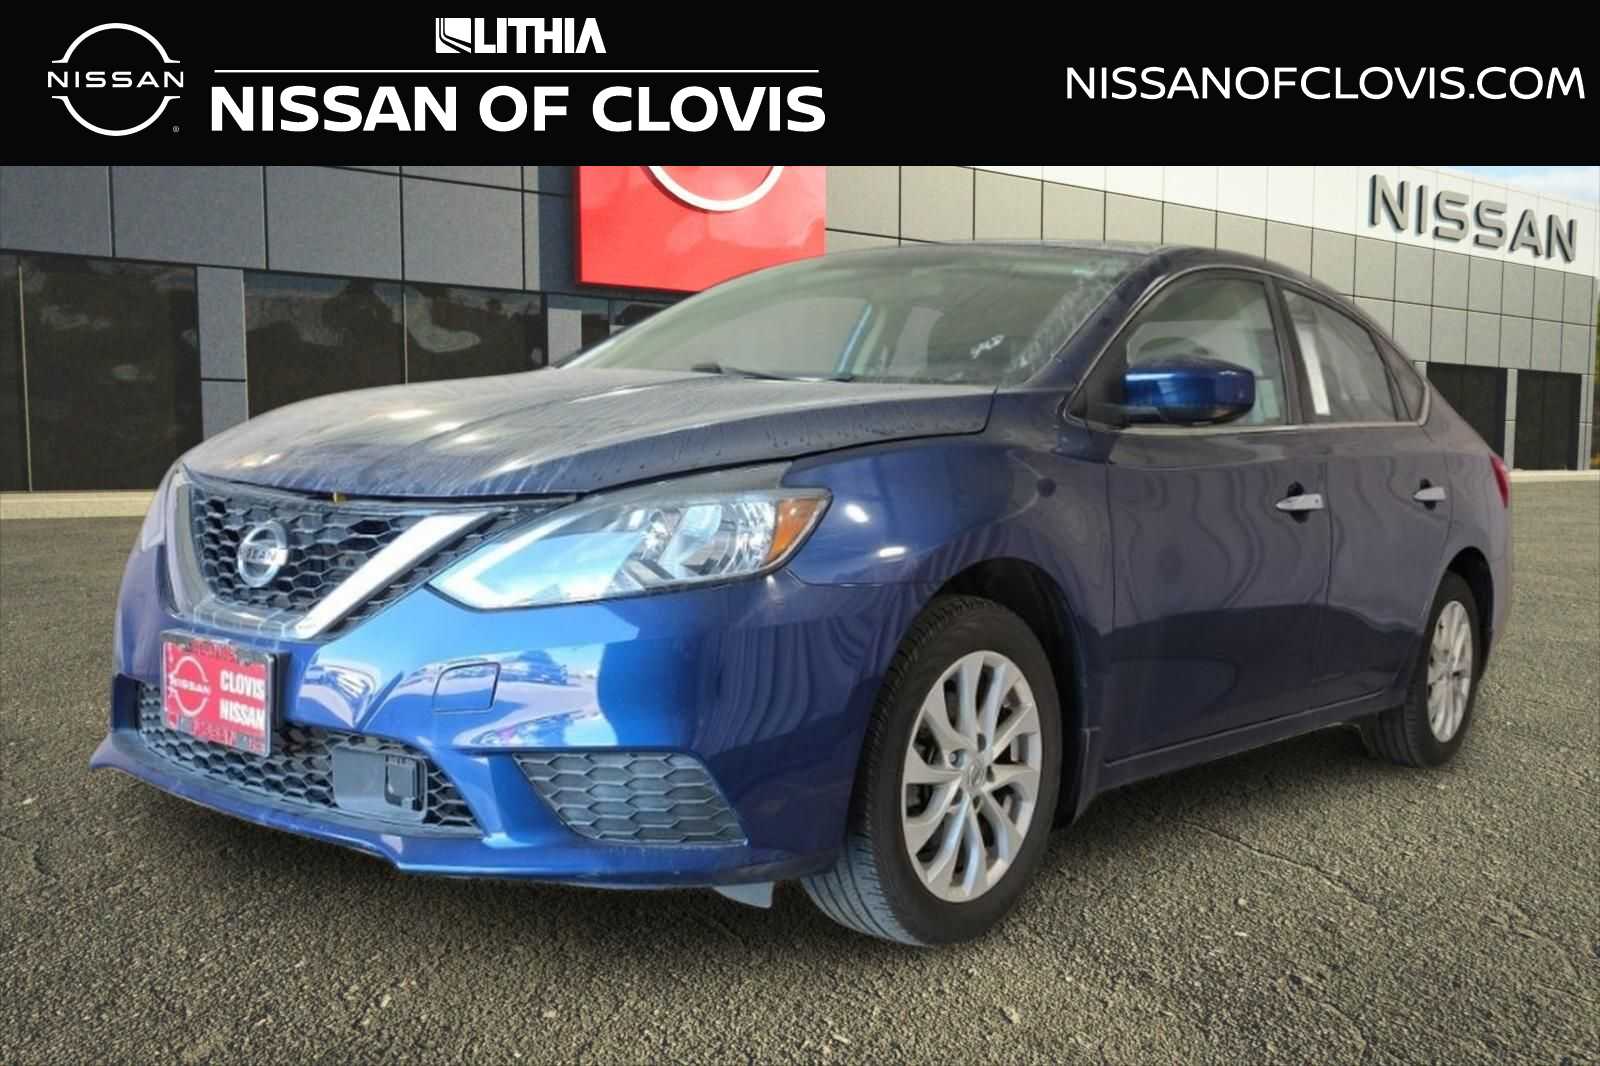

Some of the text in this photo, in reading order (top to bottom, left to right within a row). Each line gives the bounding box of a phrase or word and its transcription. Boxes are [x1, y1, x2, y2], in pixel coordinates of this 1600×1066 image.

[1369, 174, 1577, 263] NISSAN
[220, 670, 265, 701] CLOVIS
[219, 698, 265, 730] NISSAN
